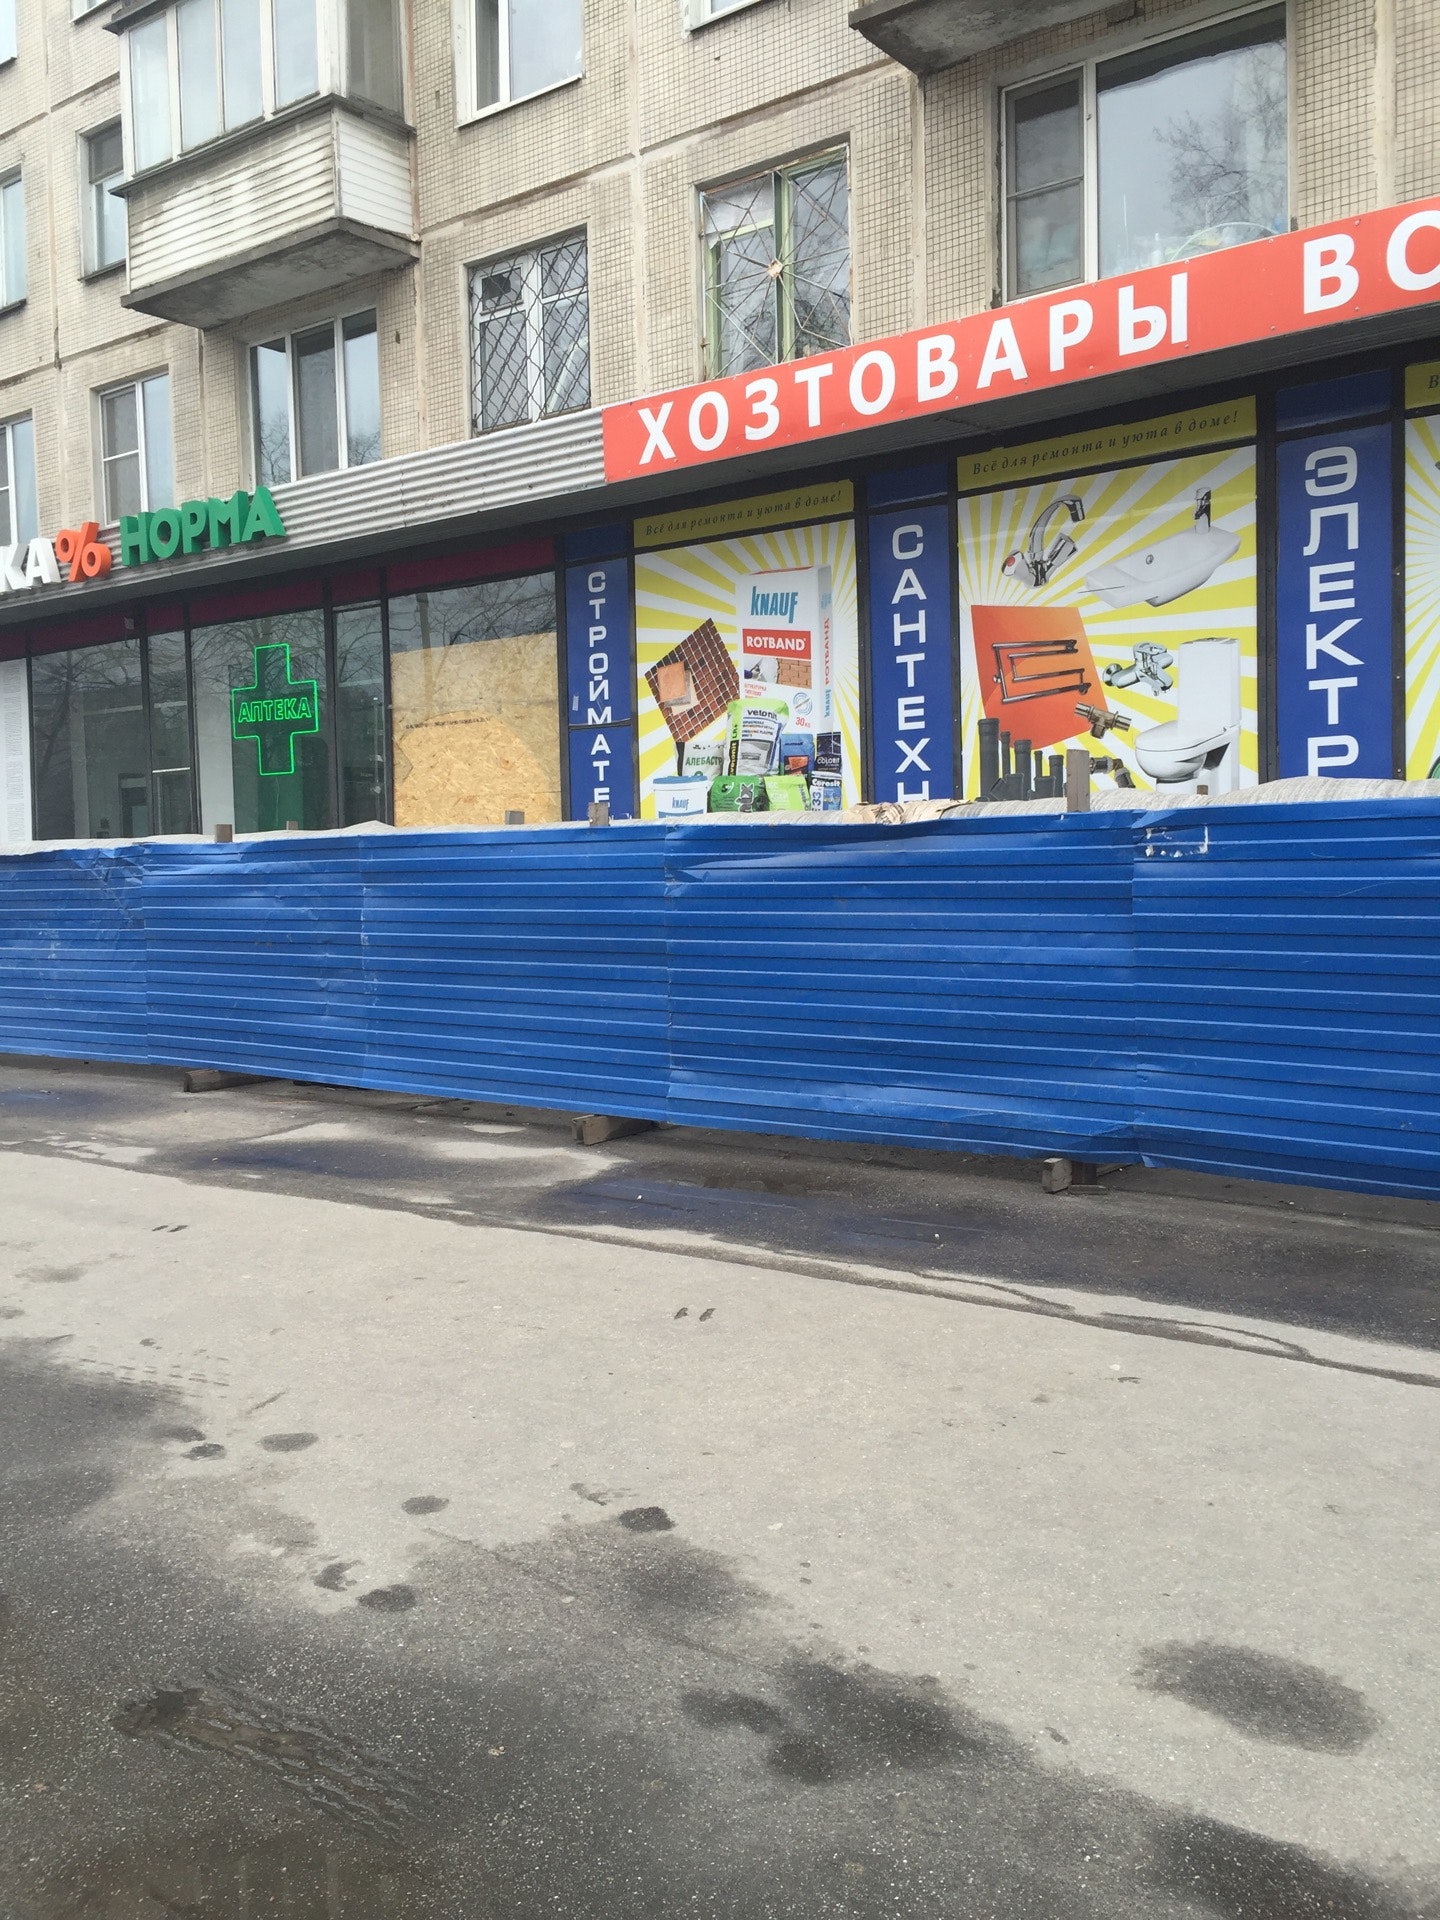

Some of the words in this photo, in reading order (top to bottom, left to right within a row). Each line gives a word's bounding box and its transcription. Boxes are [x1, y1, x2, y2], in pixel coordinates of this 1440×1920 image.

[638, 273, 1188, 465] ХОЗТОВАРЫ
[972, 460, 997, 476] Всё
[1002, 455, 1027, 472] для
[1031, 440, 1103, 467] ремонта
[1108, 436, 1117, 448] и
[1122, 426, 1168, 450] уюта
[1174, 420, 1183, 435] в
[1188, 410, 1239, 432] доме!
[119, 485, 287, 568] НОРМА
[668, 520, 687, 532] для
[690, 511, 743, 537] ремонта
[757, 503, 791, 520] уюта
[794, 496, 801, 510] в
[805, 490, 842, 507] доме!
[746, 636, 806, 652] ROTBAND
[891, 524, 931, 804] САНТЕХН
[238, 697, 312, 723] АПТЕКА
